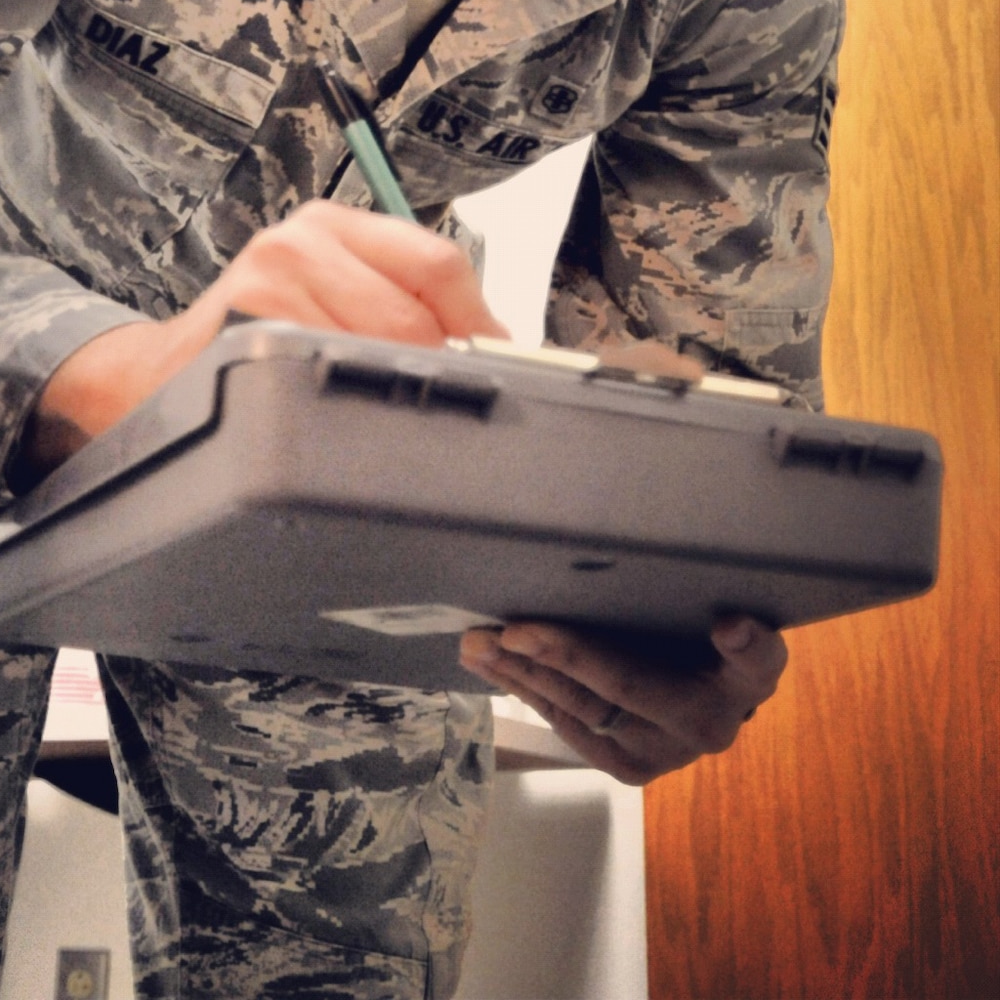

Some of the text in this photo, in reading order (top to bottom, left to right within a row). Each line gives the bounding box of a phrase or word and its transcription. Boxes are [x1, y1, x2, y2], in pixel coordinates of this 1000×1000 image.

[85, 13, 170, 75] DIAZ
[417, 100, 541, 160] U.S. AIR
